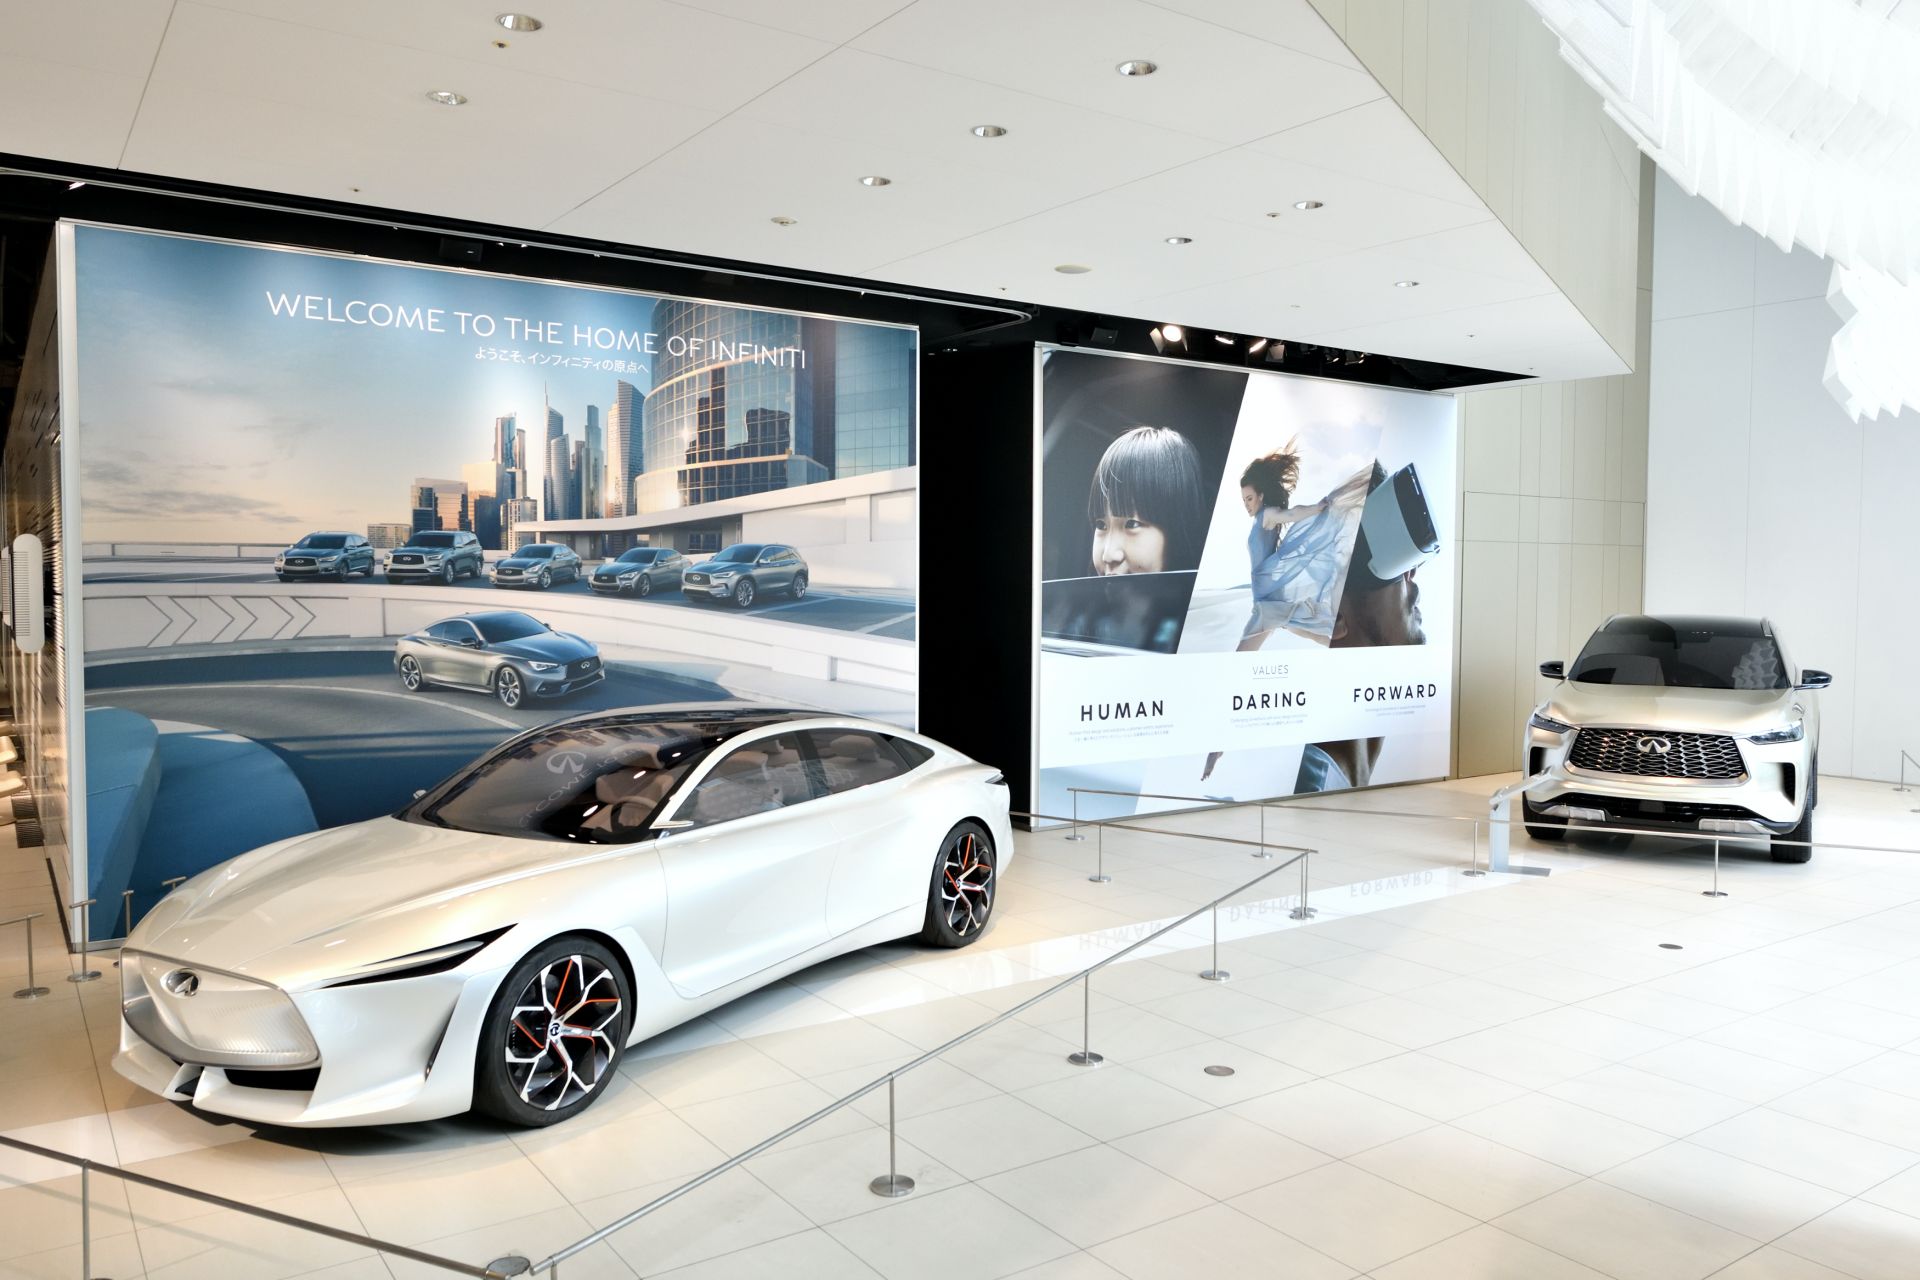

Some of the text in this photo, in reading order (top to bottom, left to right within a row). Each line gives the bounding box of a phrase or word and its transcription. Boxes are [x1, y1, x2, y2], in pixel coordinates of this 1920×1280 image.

[266, 291, 805, 369] WELCOME TO THE HOME OF INFINITI
[475, 346, 649, 374] ようこそ、インフィニティの原点へ
[1252, 664, 1290, 675] VALUES
[1232, 691, 1307, 711] DARING
[1353, 683, 1437, 702] FORWARD
[1081, 700, 1164, 721] HUMAN
